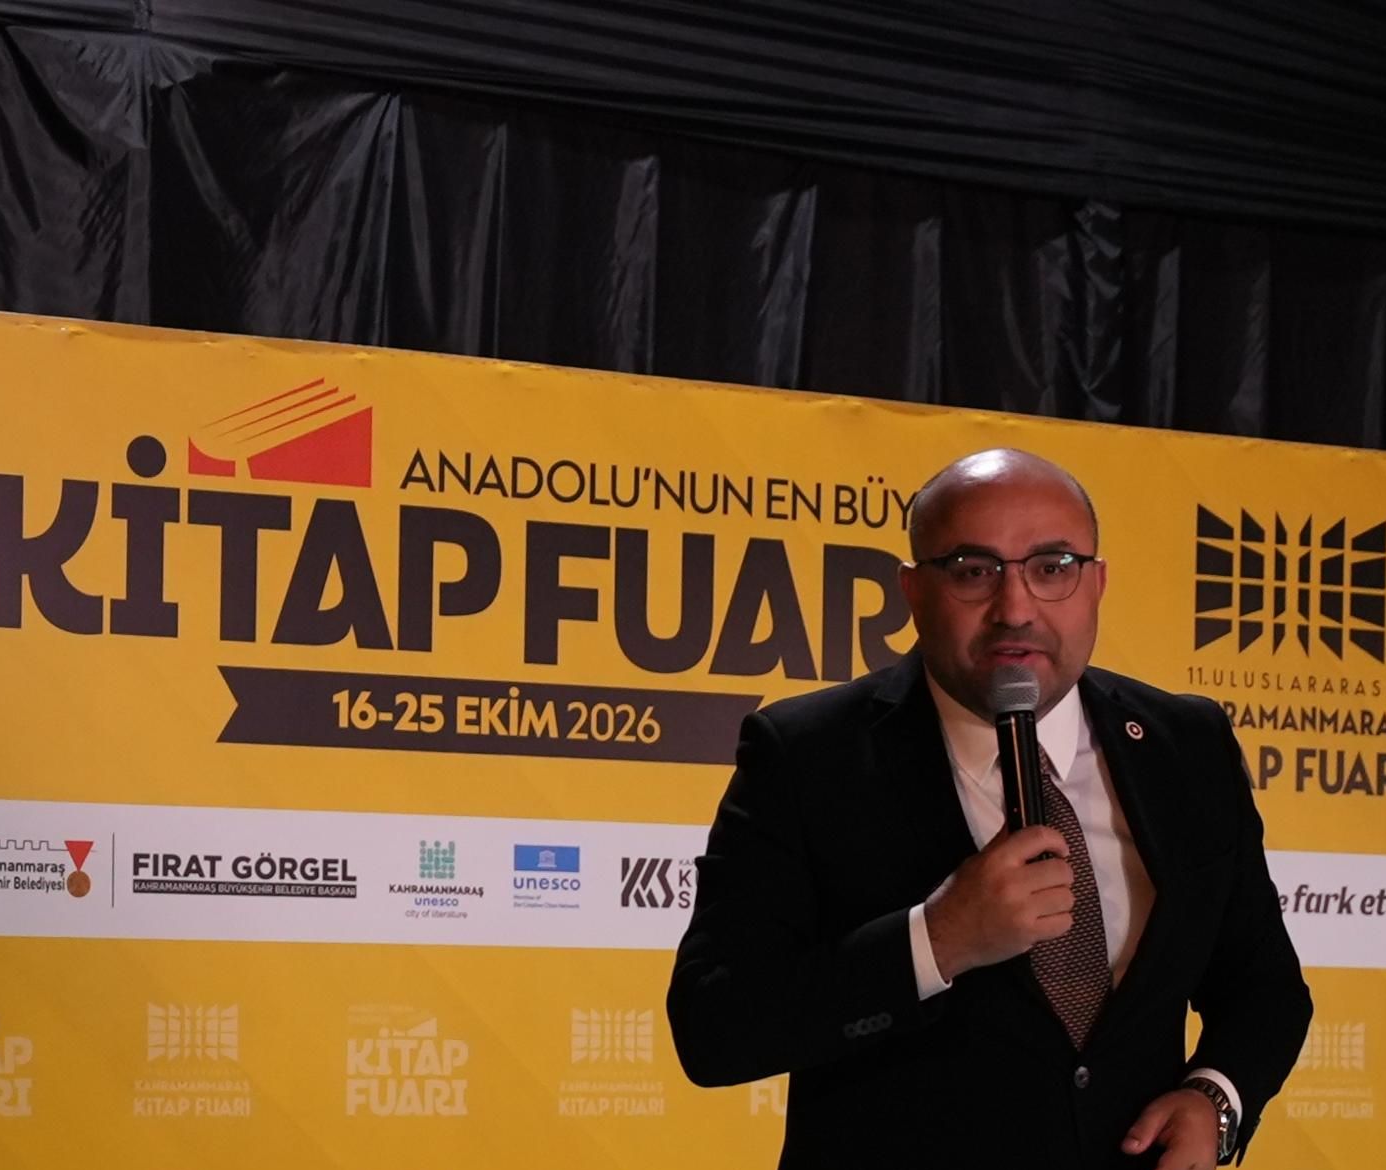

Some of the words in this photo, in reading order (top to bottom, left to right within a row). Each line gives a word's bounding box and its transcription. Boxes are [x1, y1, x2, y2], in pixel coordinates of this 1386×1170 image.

[400, 448, 754, 517] ANADOLU'NUN
[766, 478, 822, 523] EN
[524, 519, 917, 682] FUAR
[332, 688, 445, 732] 16-25
[456, 686, 559, 738] EKİM
[566, 702, 661, 744] 2026
[133, 853, 222, 878] FIRAT
[231, 852, 357, 882] GÖRGEL
[13, 876, 66, 893] Belediyesi
[389, 884, 484, 898] KAHRAMANMARAŞ
[513, 876, 581, 891] unesco
[414, 896, 460, 907] unesco
[1292, 884, 1357, 915] fark
[346, 1079, 468, 1116] FUARI
